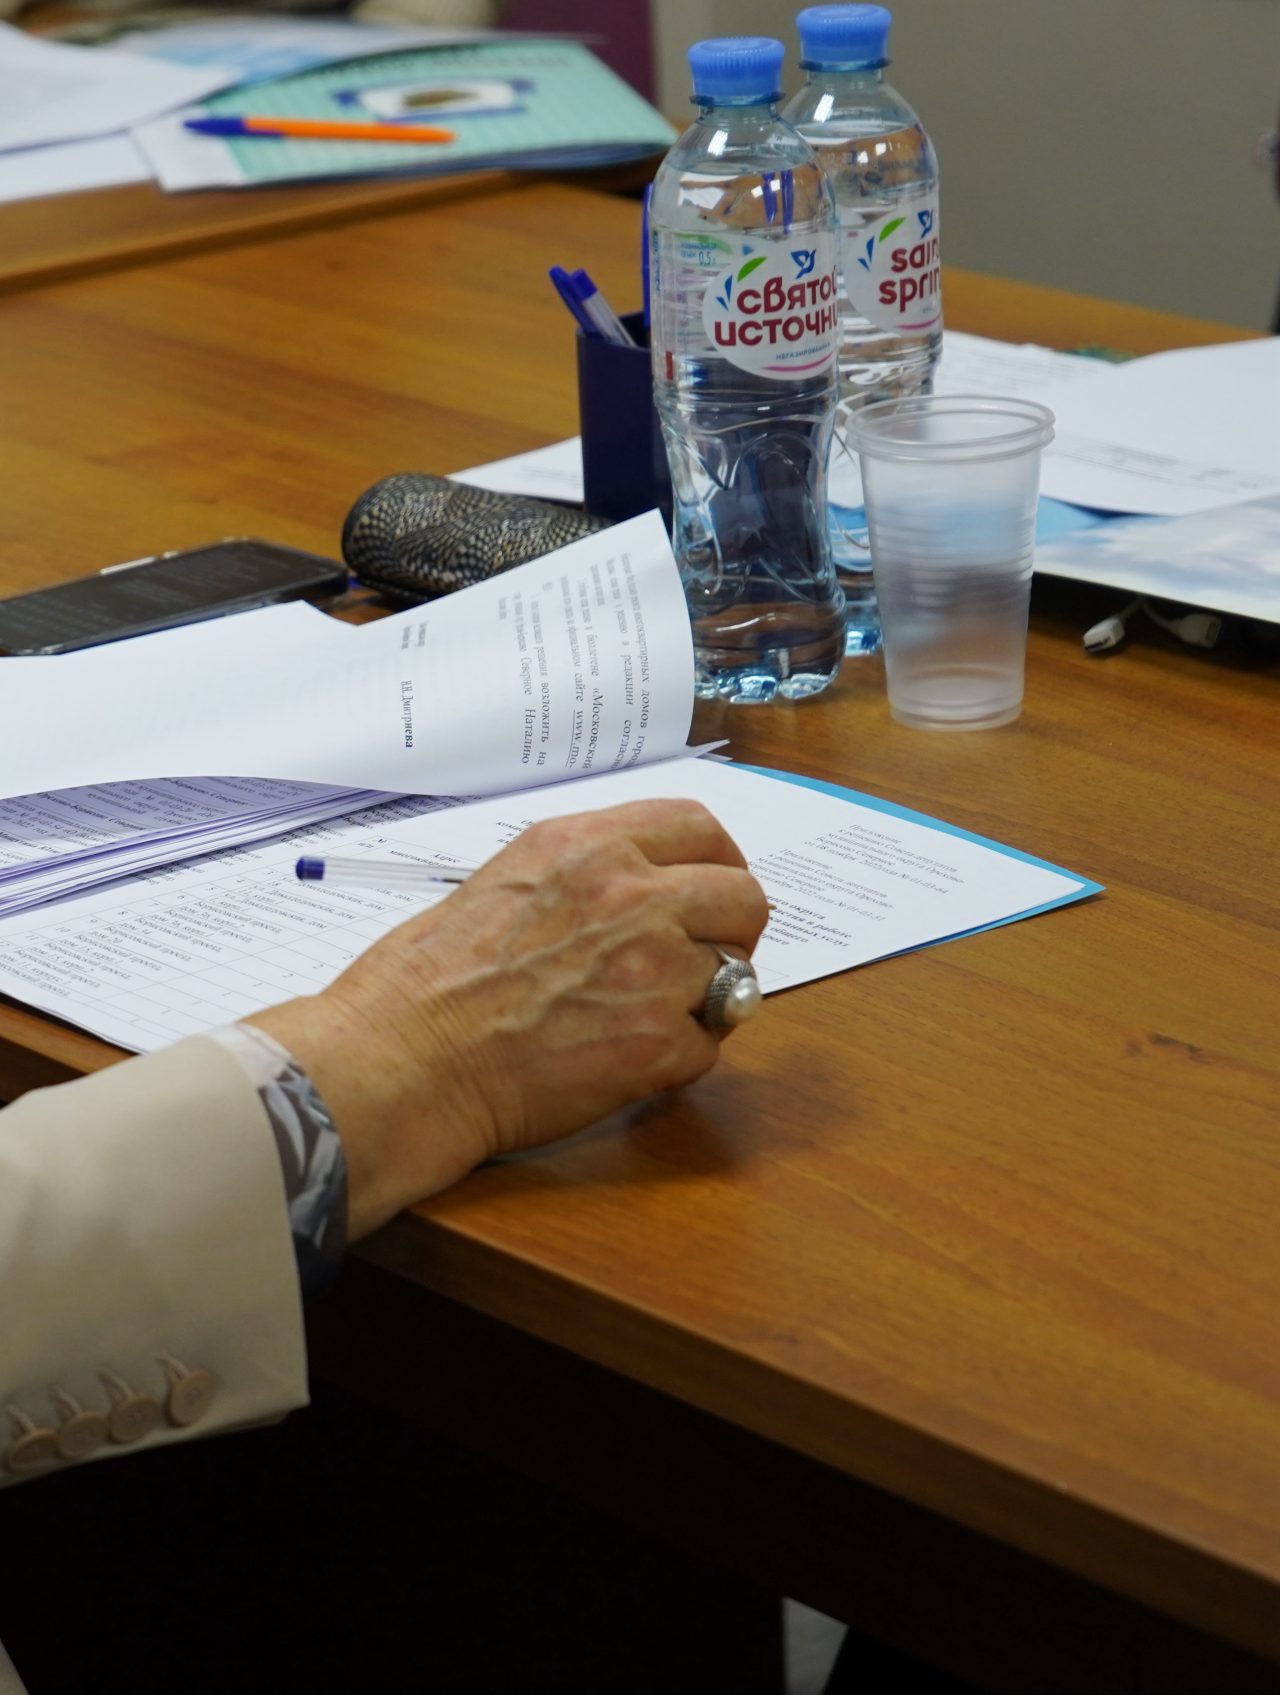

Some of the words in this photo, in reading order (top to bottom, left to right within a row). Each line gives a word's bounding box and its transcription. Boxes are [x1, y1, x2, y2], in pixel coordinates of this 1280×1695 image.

[890, 237, 939, 273] sain
[878, 266, 940, 313] sprin
[714, 302, 838, 347] источн
